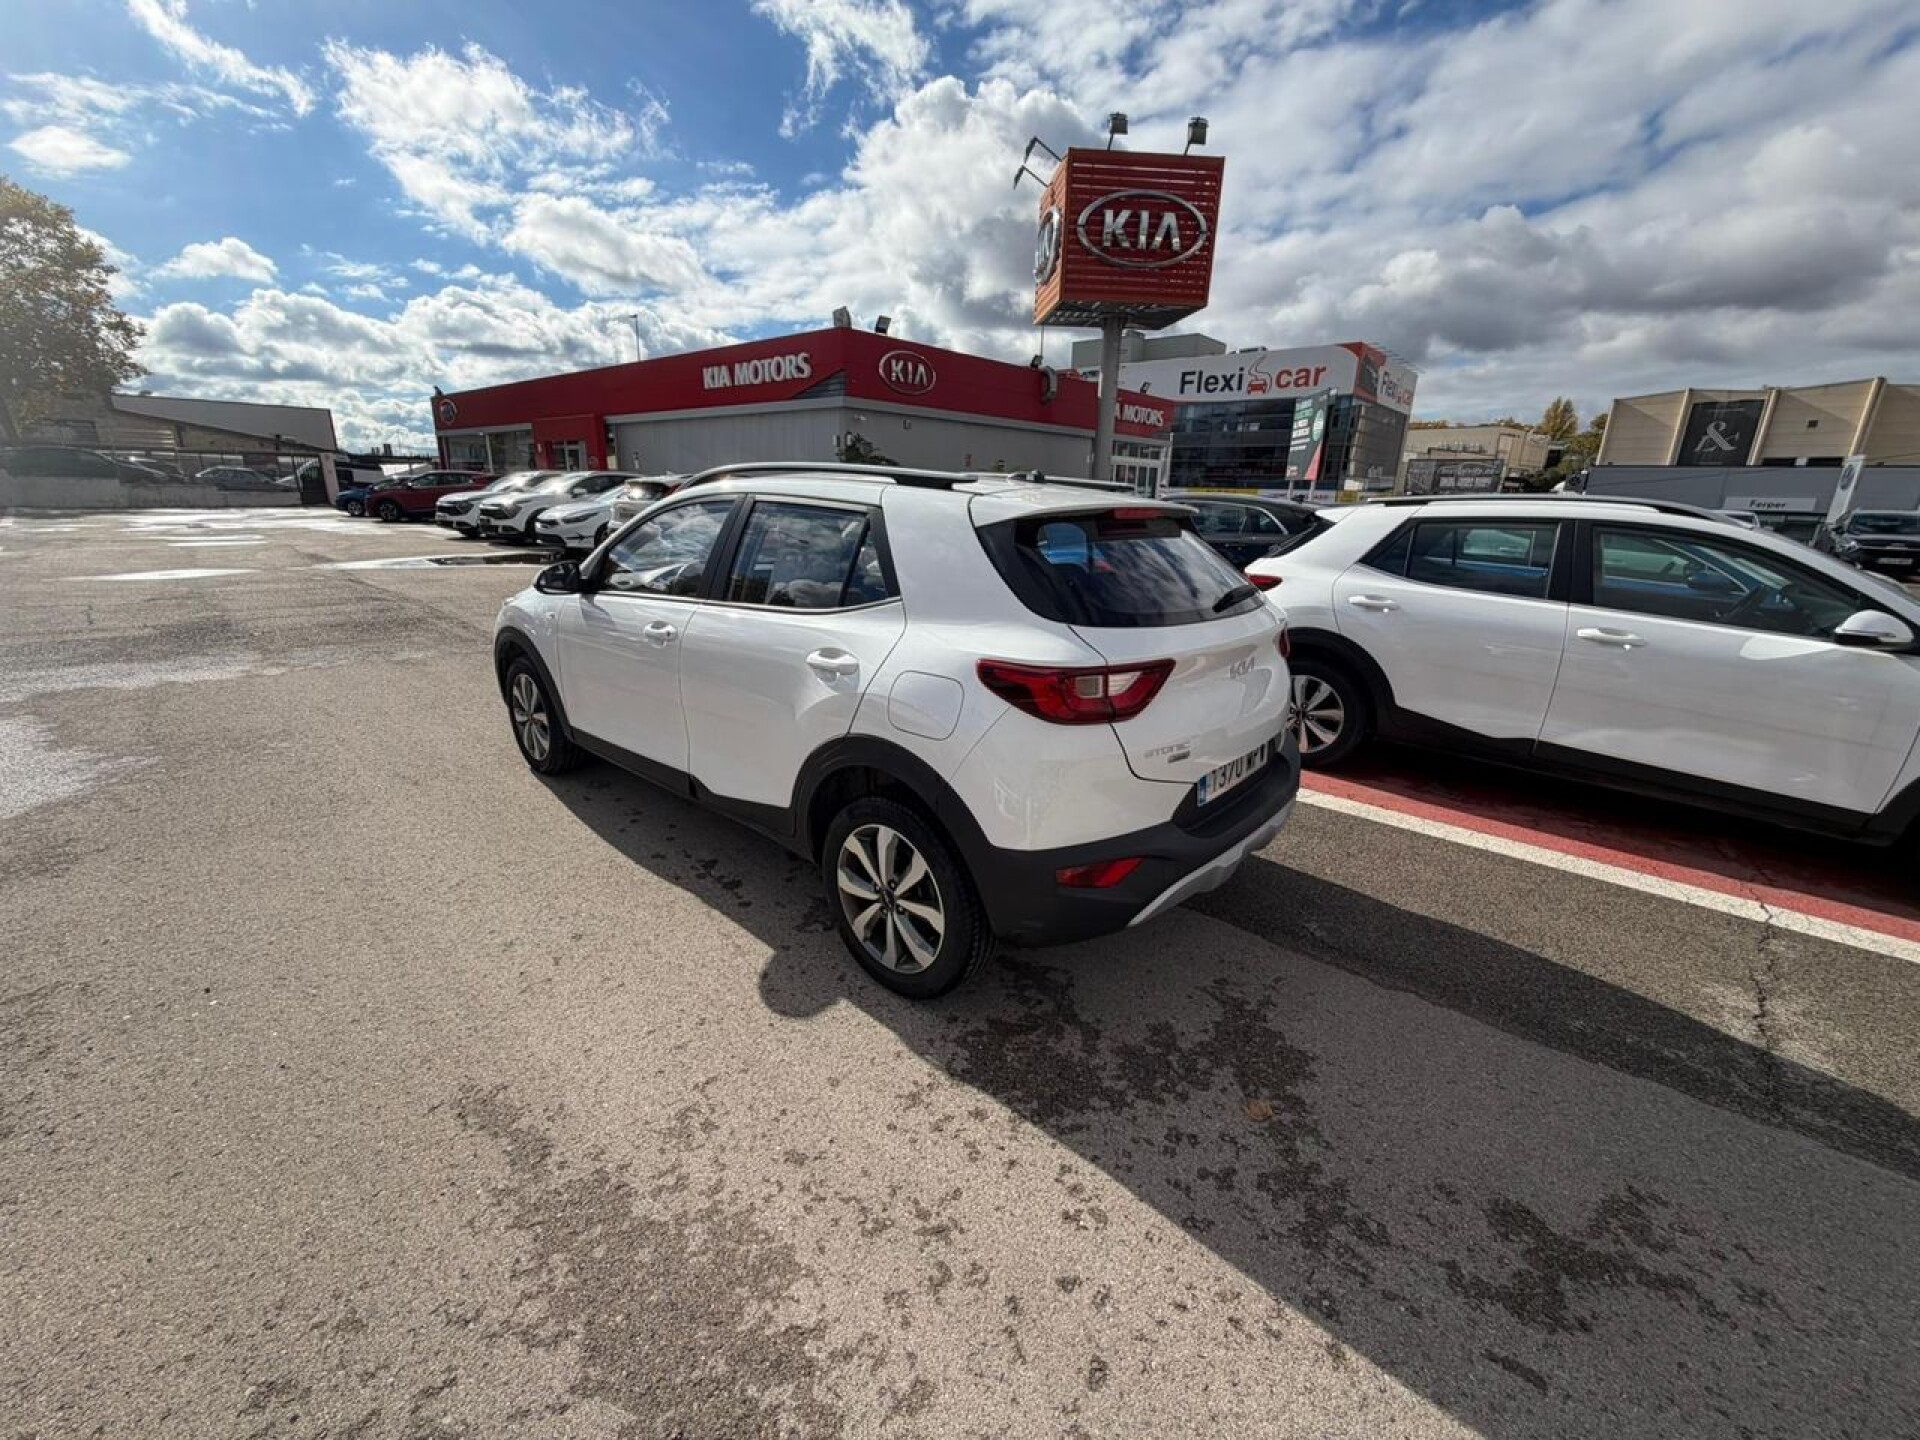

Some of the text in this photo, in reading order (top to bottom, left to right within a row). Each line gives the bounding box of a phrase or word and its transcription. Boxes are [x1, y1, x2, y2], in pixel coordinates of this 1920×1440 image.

[1103, 209, 1182, 251] KIA
[703, 352, 812, 389] KIA MOTORS
[891, 359, 928, 385] KIA
[1179, 366, 1327, 394] Flexi car
[1122, 404, 1165, 427] MOTORS
